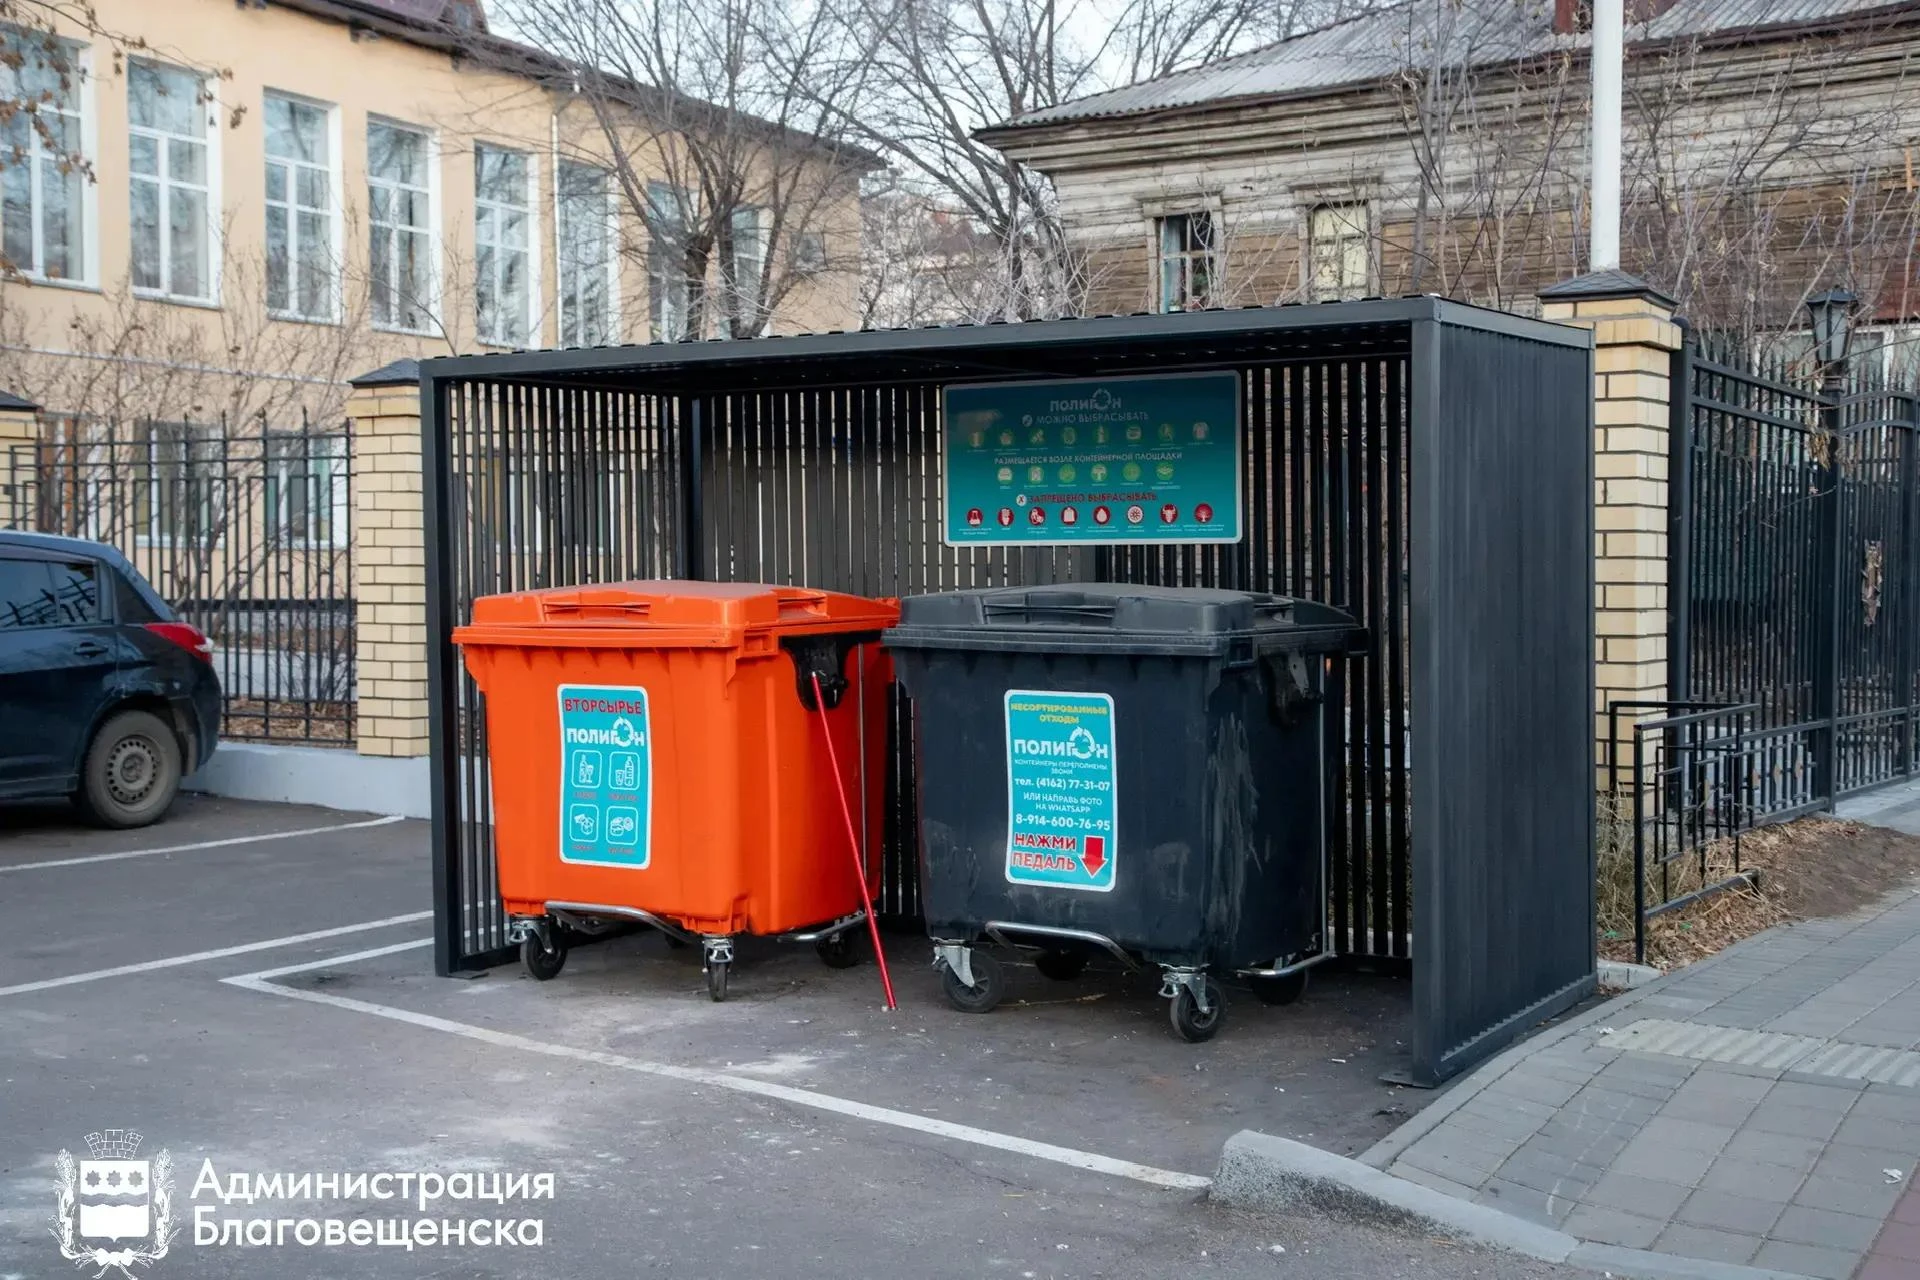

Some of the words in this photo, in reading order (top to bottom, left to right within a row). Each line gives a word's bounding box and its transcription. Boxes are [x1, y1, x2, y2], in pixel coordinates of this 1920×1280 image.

[1050, 388, 1121, 412] ПОЛИГОН
[1036, 414, 1075, 424] МОЖНО
[1078, 412, 1149, 423] ВЫБРАСЫВАТЬ
[995, 457, 1047, 465] РАЗМЕЩАЕТСЯ
[1049, 455, 1072, 463] ВОЗЛЕ
[1075, 454, 1133, 463] КОНТЕЙНЕРНОЙ
[1135, 452, 1182, 461] ПЛОЩАДКИ
[1028, 494, 1085, 504] ЗАПРЕЩЕНО
[1088, 492, 1158, 502] ВЫБРАСЫВАТЬ
[564, 698, 641, 714] ВТОРСЫРЬЕ
[1011, 703, 1107, 714] НЕСОРТИРОВАННЫЕ
[1040, 714, 1079, 724] ОТХОДЫ
[567, 716, 645, 747] ПОЛИГОН
[1014, 727, 1108, 759] ПОЛИГОН
[1015, 759, 1057, 767] КОНТЕЙНЕРЫ
[1059, 761, 1107, 770] ПЕРЕПОЛНЕНЫ
[1015, 778, 1034, 786] тел.
[1036, 777, 1066, 790] (4162)
[1069, 779, 1110, 791] 77-31-07
[1024, 792, 1040, 801] ИЛИ
[1042, 793, 1078, 804] НАПРАВЬ
[1080, 796, 1102, 806] ФОТО
[1036, 803, 1046, 811] НА
[1048, 804, 1090, 813] WHATSAPP
[1016, 814, 1110, 830] 8-914-600-76-95
[1015, 833, 1076, 850] НАЖМИ
[1013, 852, 1076, 872] ПЕДАЛЬ
